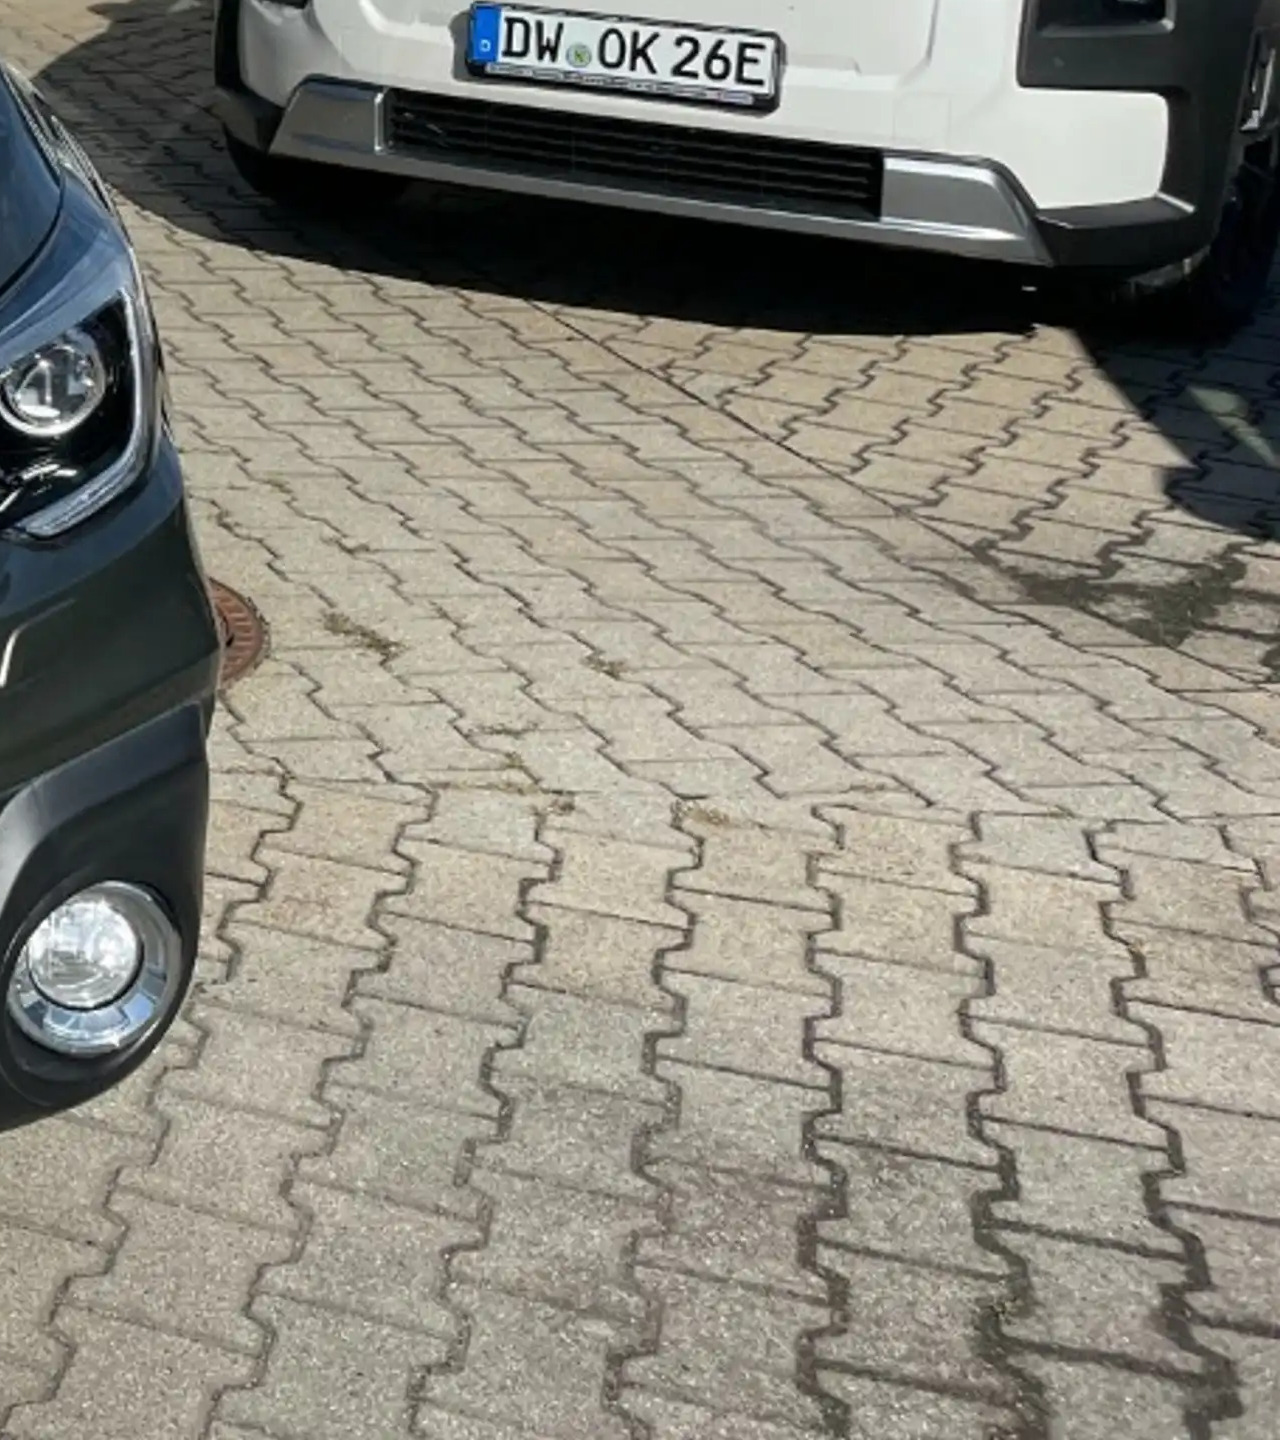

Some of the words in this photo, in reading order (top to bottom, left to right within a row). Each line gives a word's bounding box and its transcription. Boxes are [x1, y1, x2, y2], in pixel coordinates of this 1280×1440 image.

[502, 16, 565, 64] DW
[597, 28, 661, 76] OK
[671, 35, 768, 88] 26E
